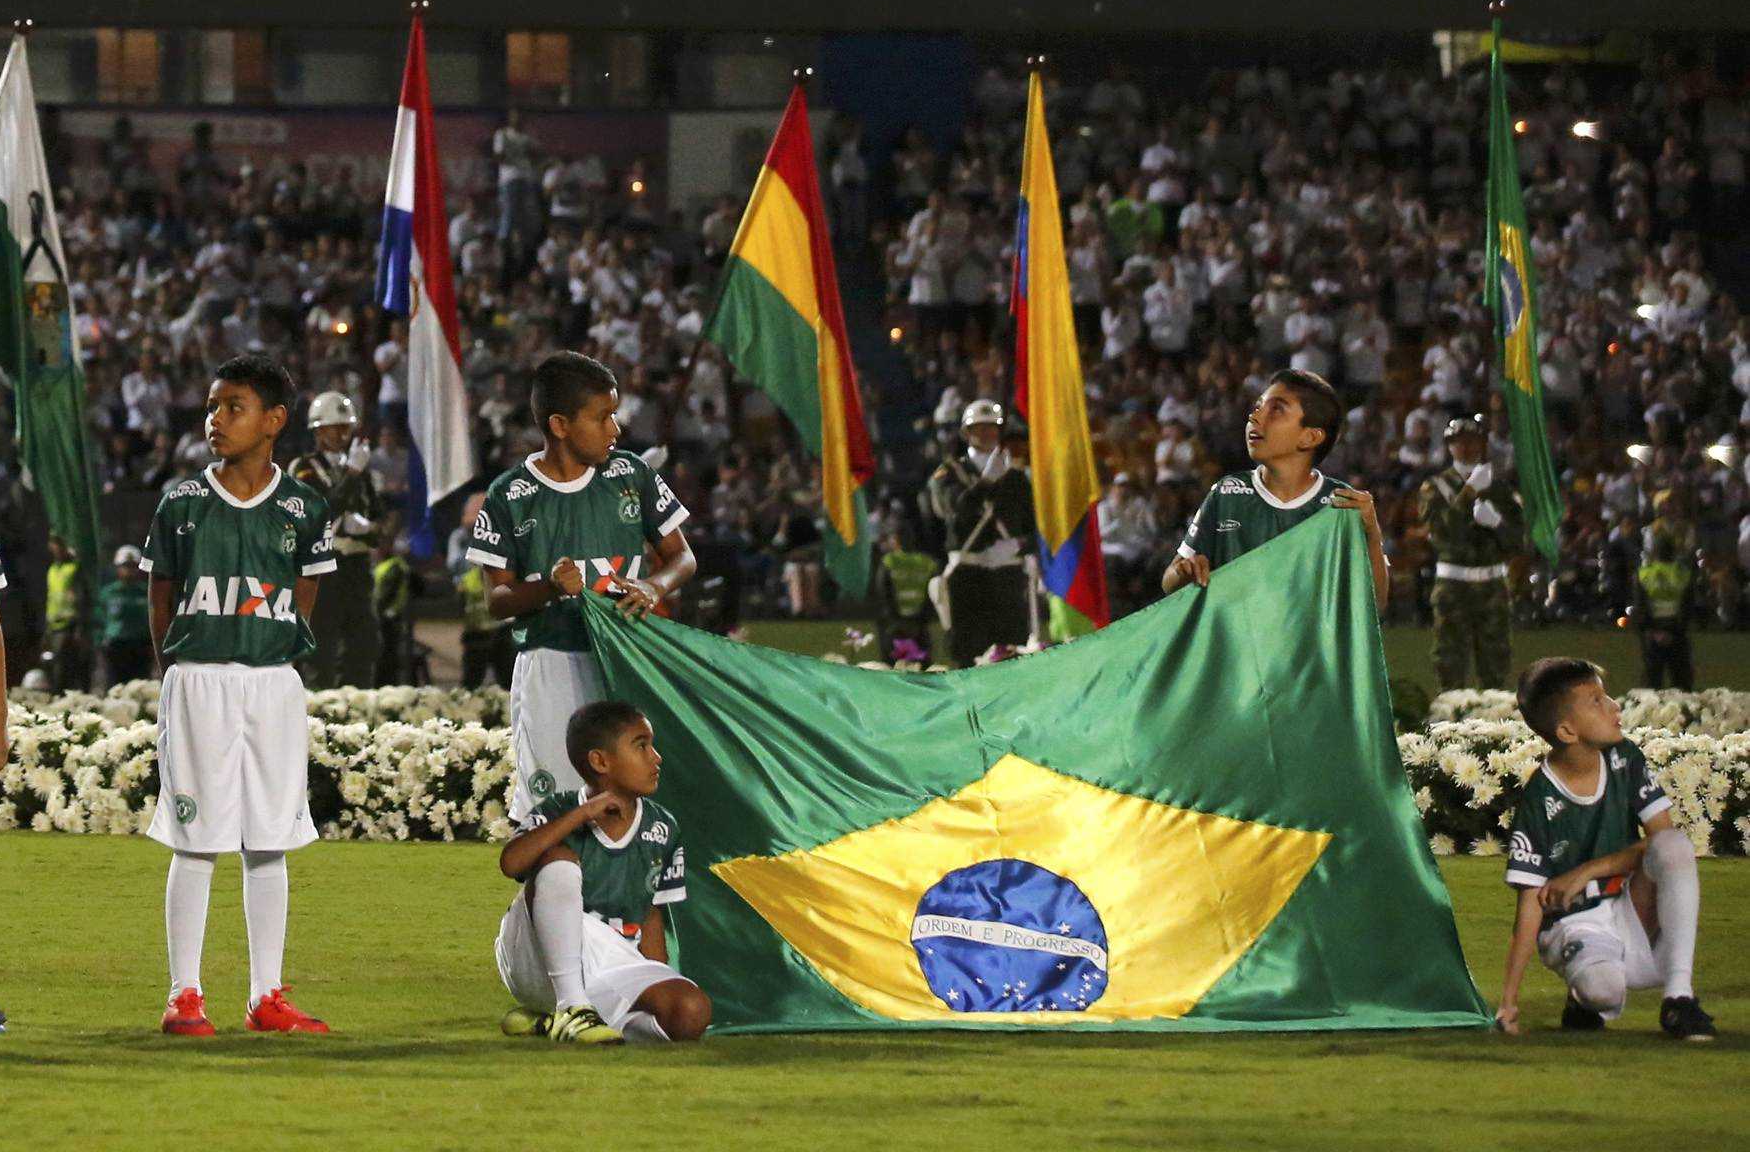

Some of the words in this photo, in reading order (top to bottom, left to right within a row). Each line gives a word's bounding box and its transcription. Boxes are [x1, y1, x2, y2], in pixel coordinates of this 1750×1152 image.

[177, 576, 296, 624] AIXA
[918, 918, 972, 938] ORDEM
[984, 927, 994, 940] E
[1004, 928, 1101, 960] PROGRESSO
